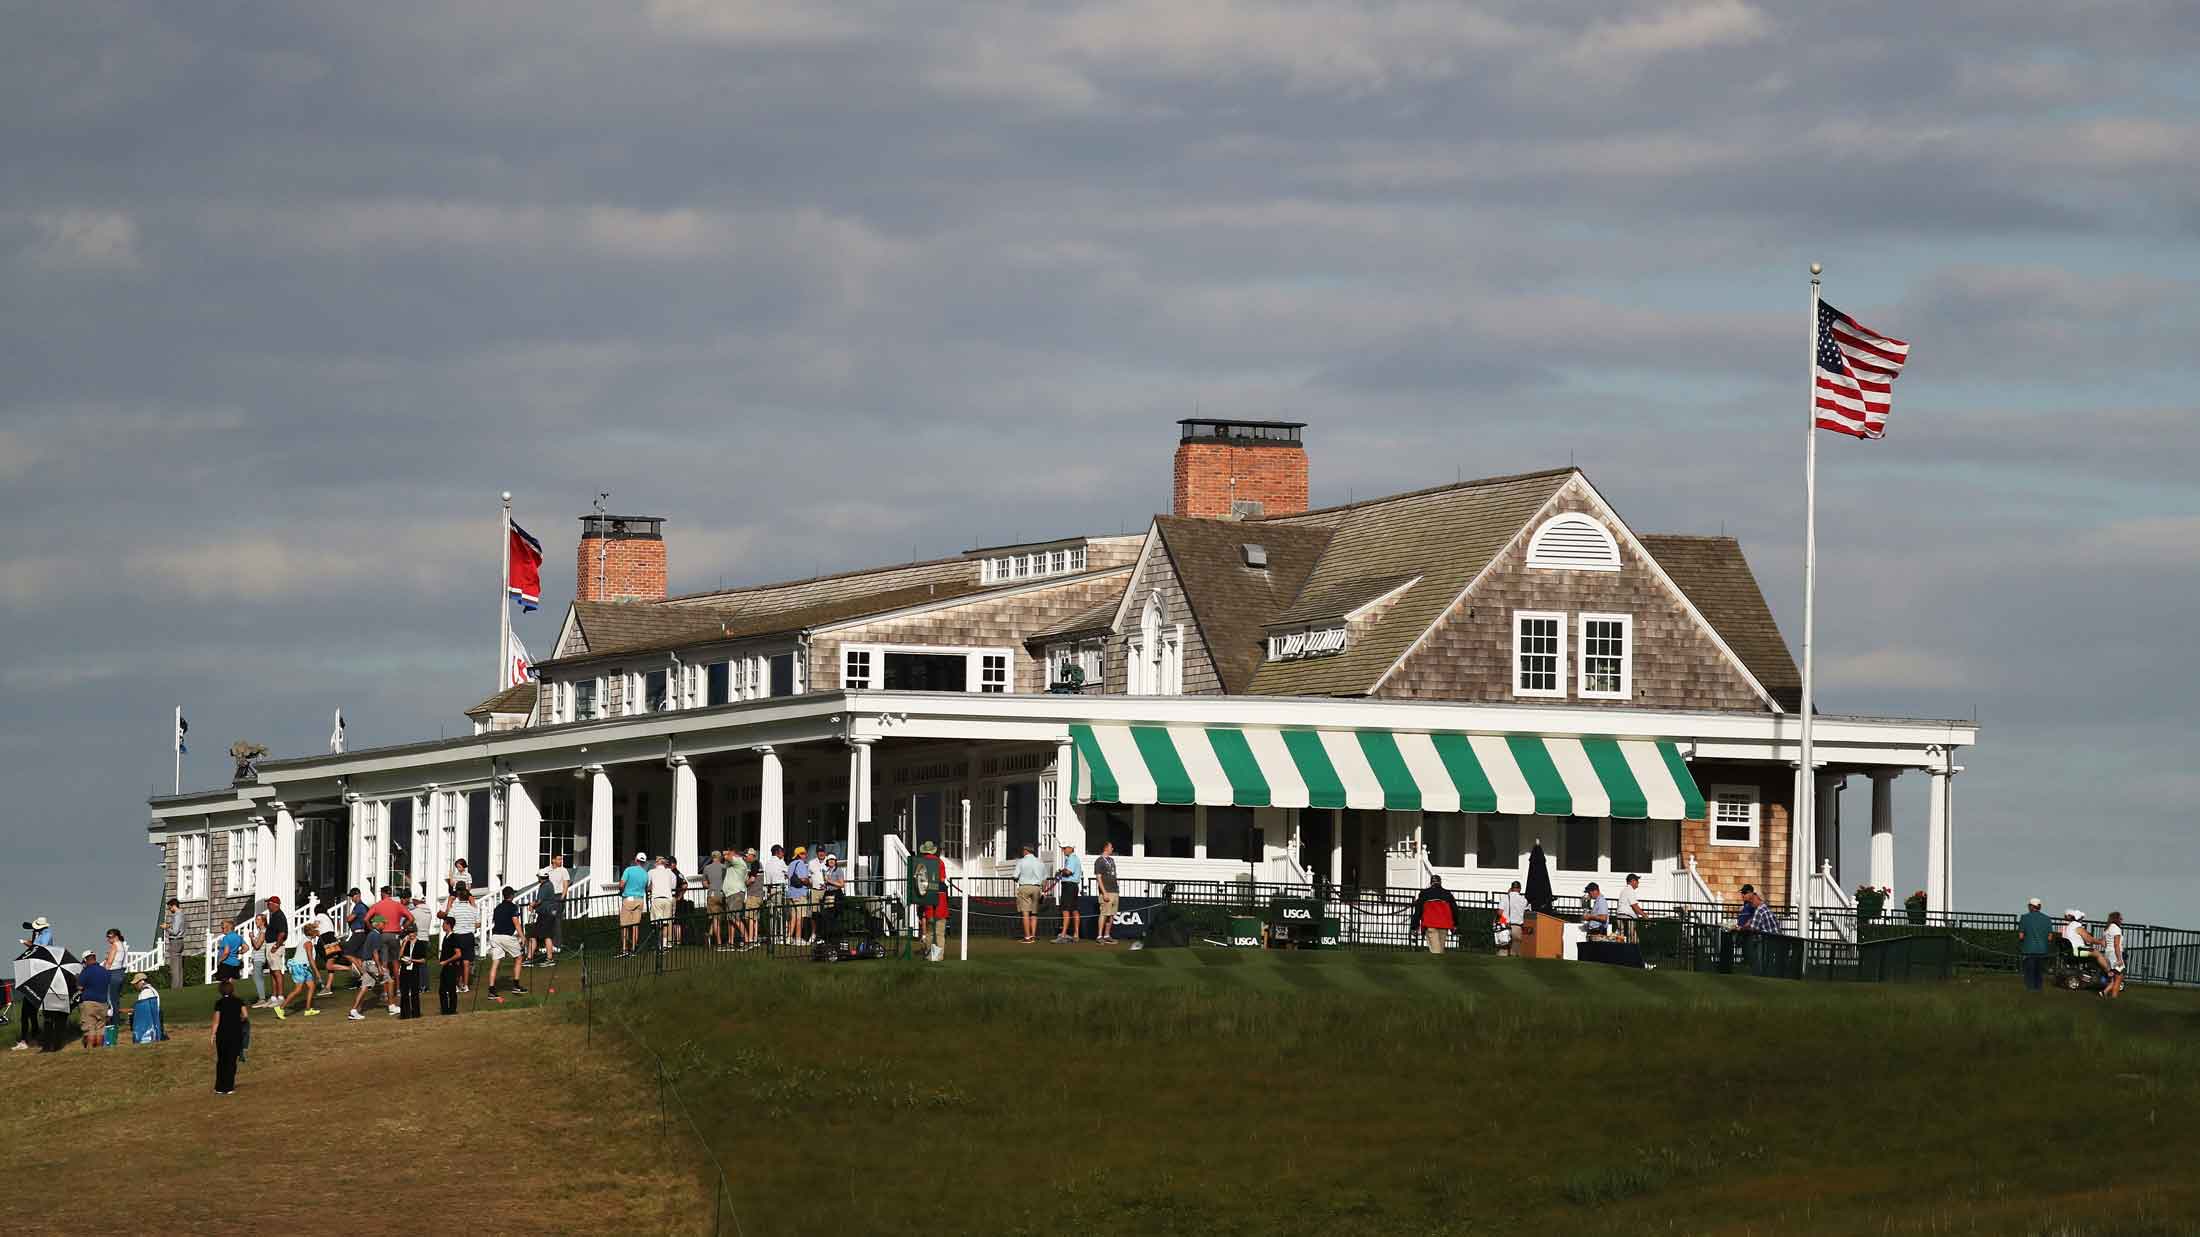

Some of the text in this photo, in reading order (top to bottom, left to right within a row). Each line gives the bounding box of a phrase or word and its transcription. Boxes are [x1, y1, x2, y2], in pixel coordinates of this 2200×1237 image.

[1113, 911, 1143, 925] SGA
[1283, 908, 1312, 919] USGA
[1234, 937, 1259, 946] USGA
[1321, 936, 1337, 945] USGA
